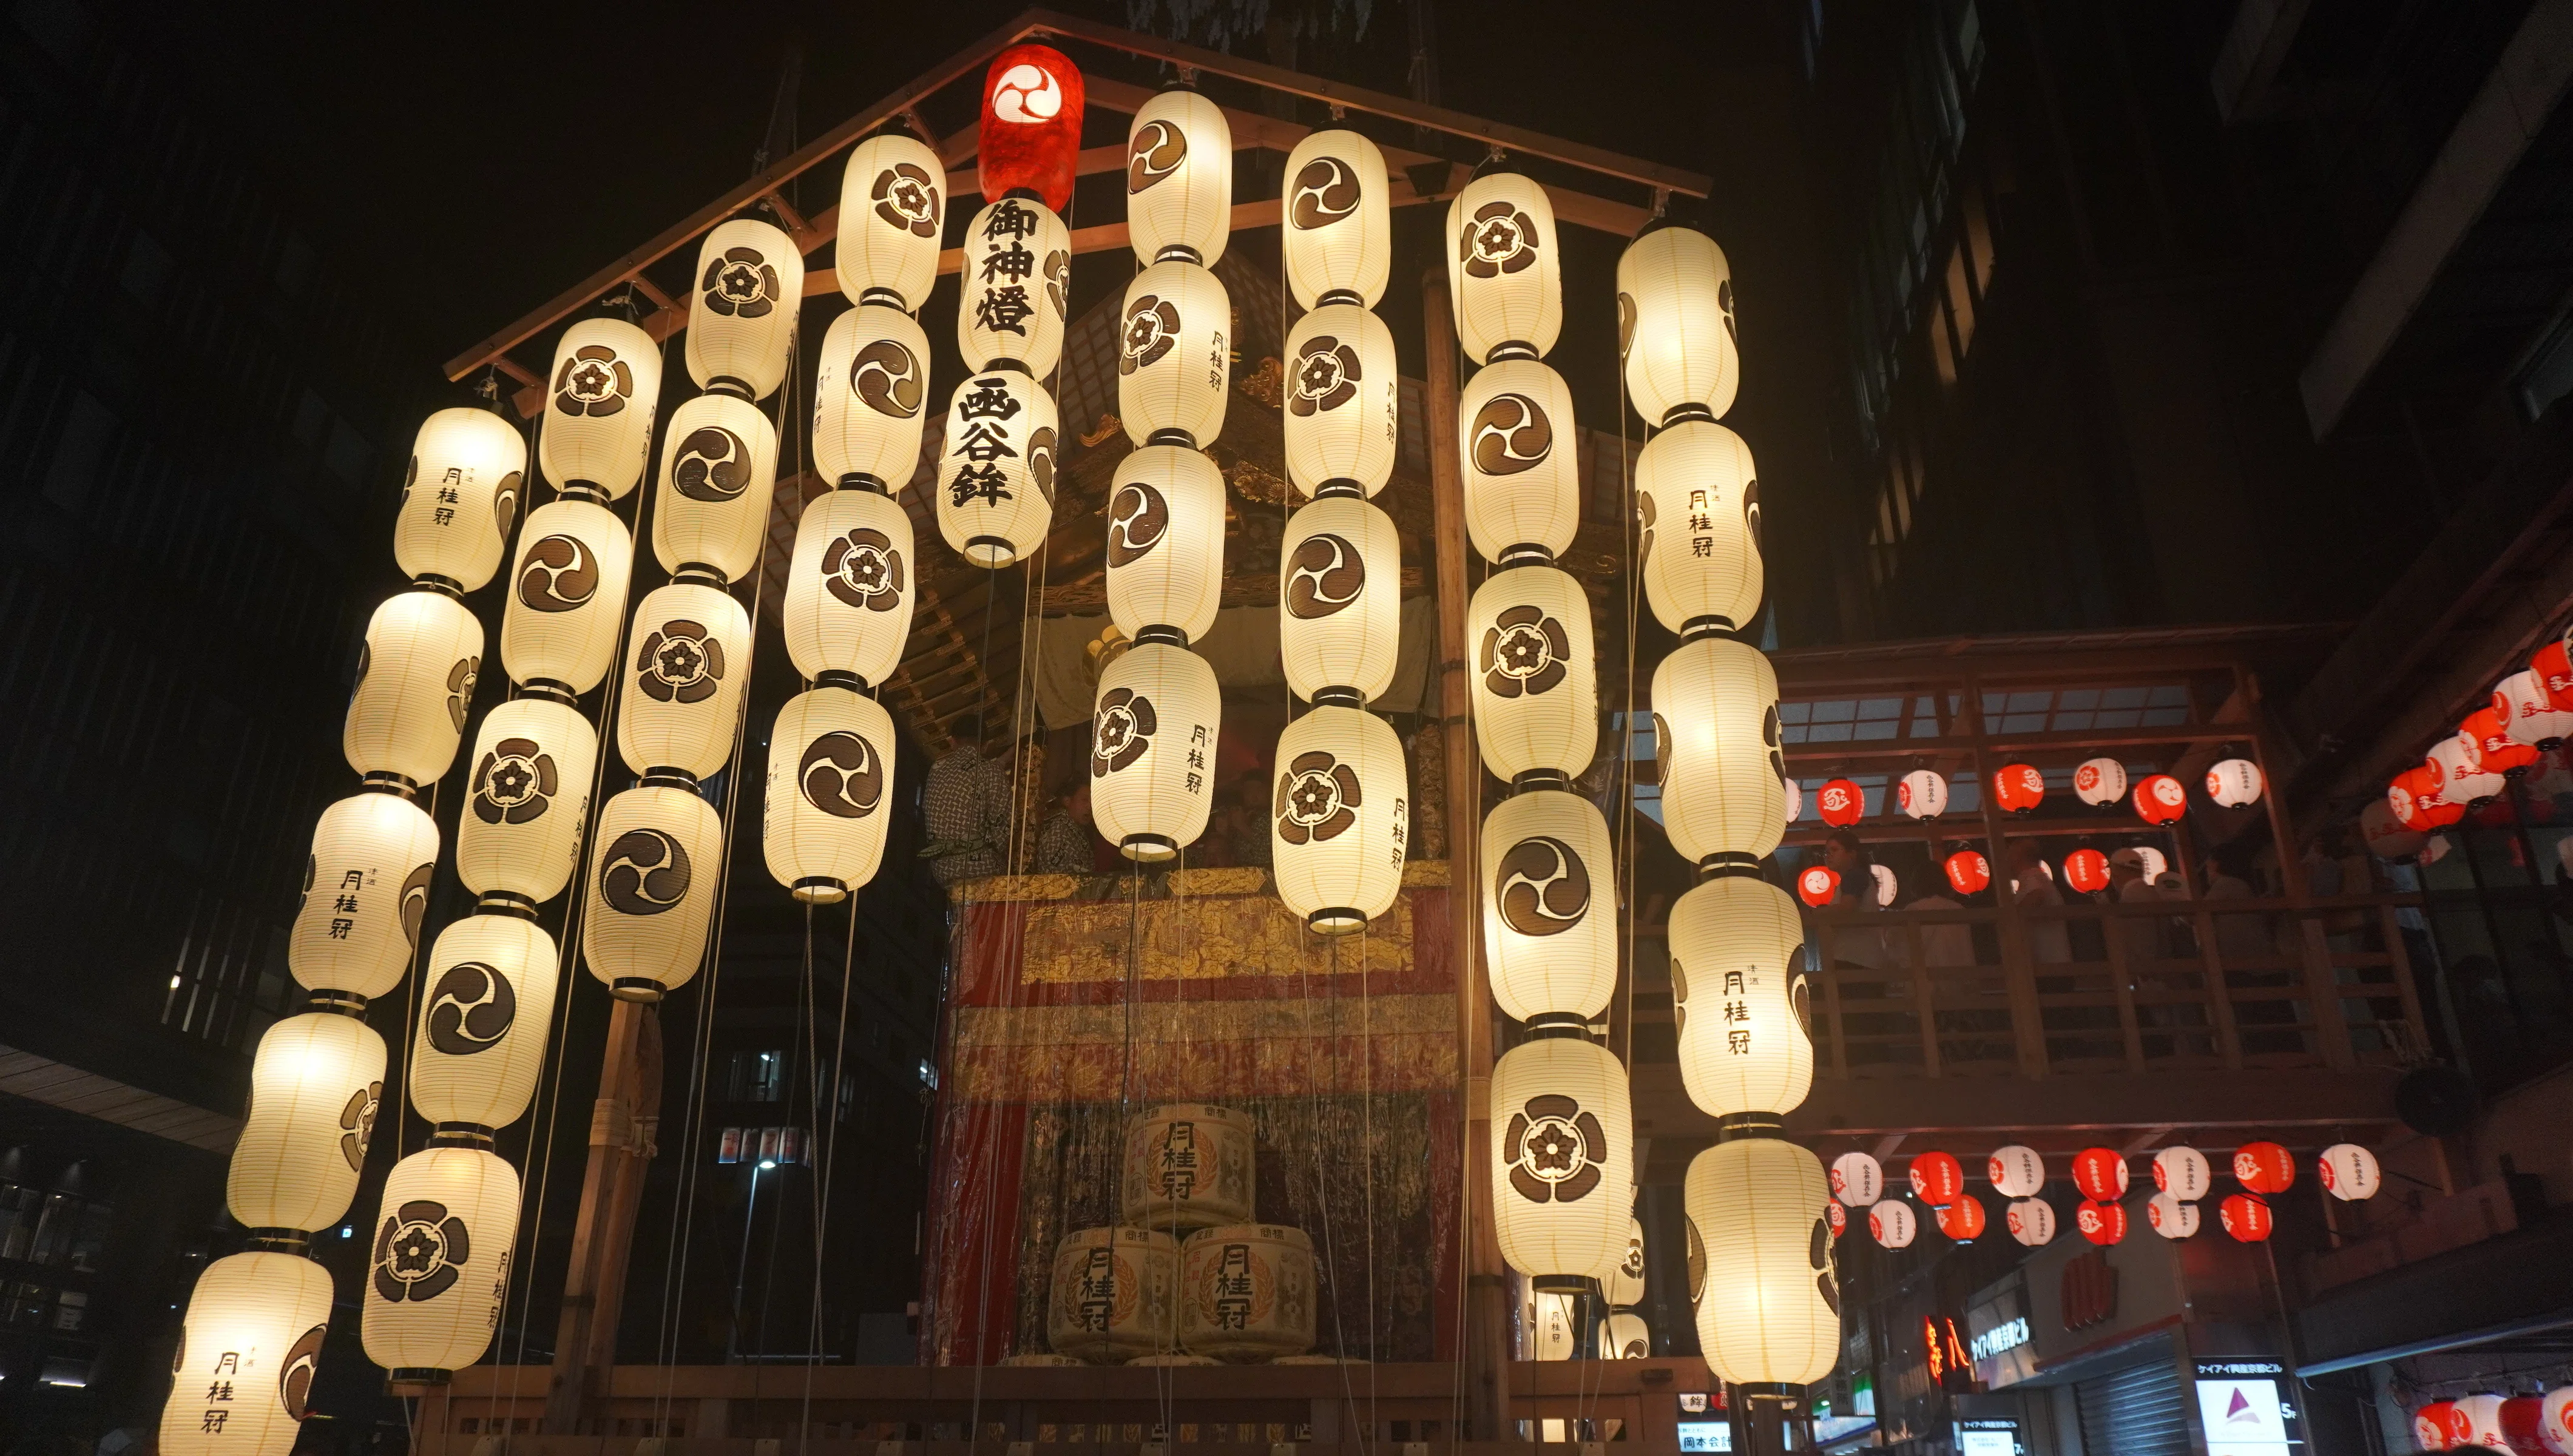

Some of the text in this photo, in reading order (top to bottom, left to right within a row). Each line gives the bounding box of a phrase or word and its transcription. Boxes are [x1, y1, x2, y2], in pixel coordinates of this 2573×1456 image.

[975, 200, 1039, 337] 御神燈
[1209, 331, 1223, 392] 月桂冠
[432, 468, 462, 526] 月桂冠
[1689, 490, 1714, 558] 月桂冠
[1185, 724, 1206, 796] 月桂冠
[1390, 798, 1406, 871] 月桂冠
[328, 871, 363, 939] 月桂冠
[1723, 971, 1751, 1054] 月桂冠
[1161, 1122, 1197, 1201] 月桂冠
[1260, 1227, 1284, 1239] 商標
[1080, 1247, 1115, 1332] 月桂冠
[1215, 1244, 1253, 1330] 月桂冠
[1551, 1312, 1561, 1343] 月桂冠
[200, 1352, 240, 1434] 月桂冠
